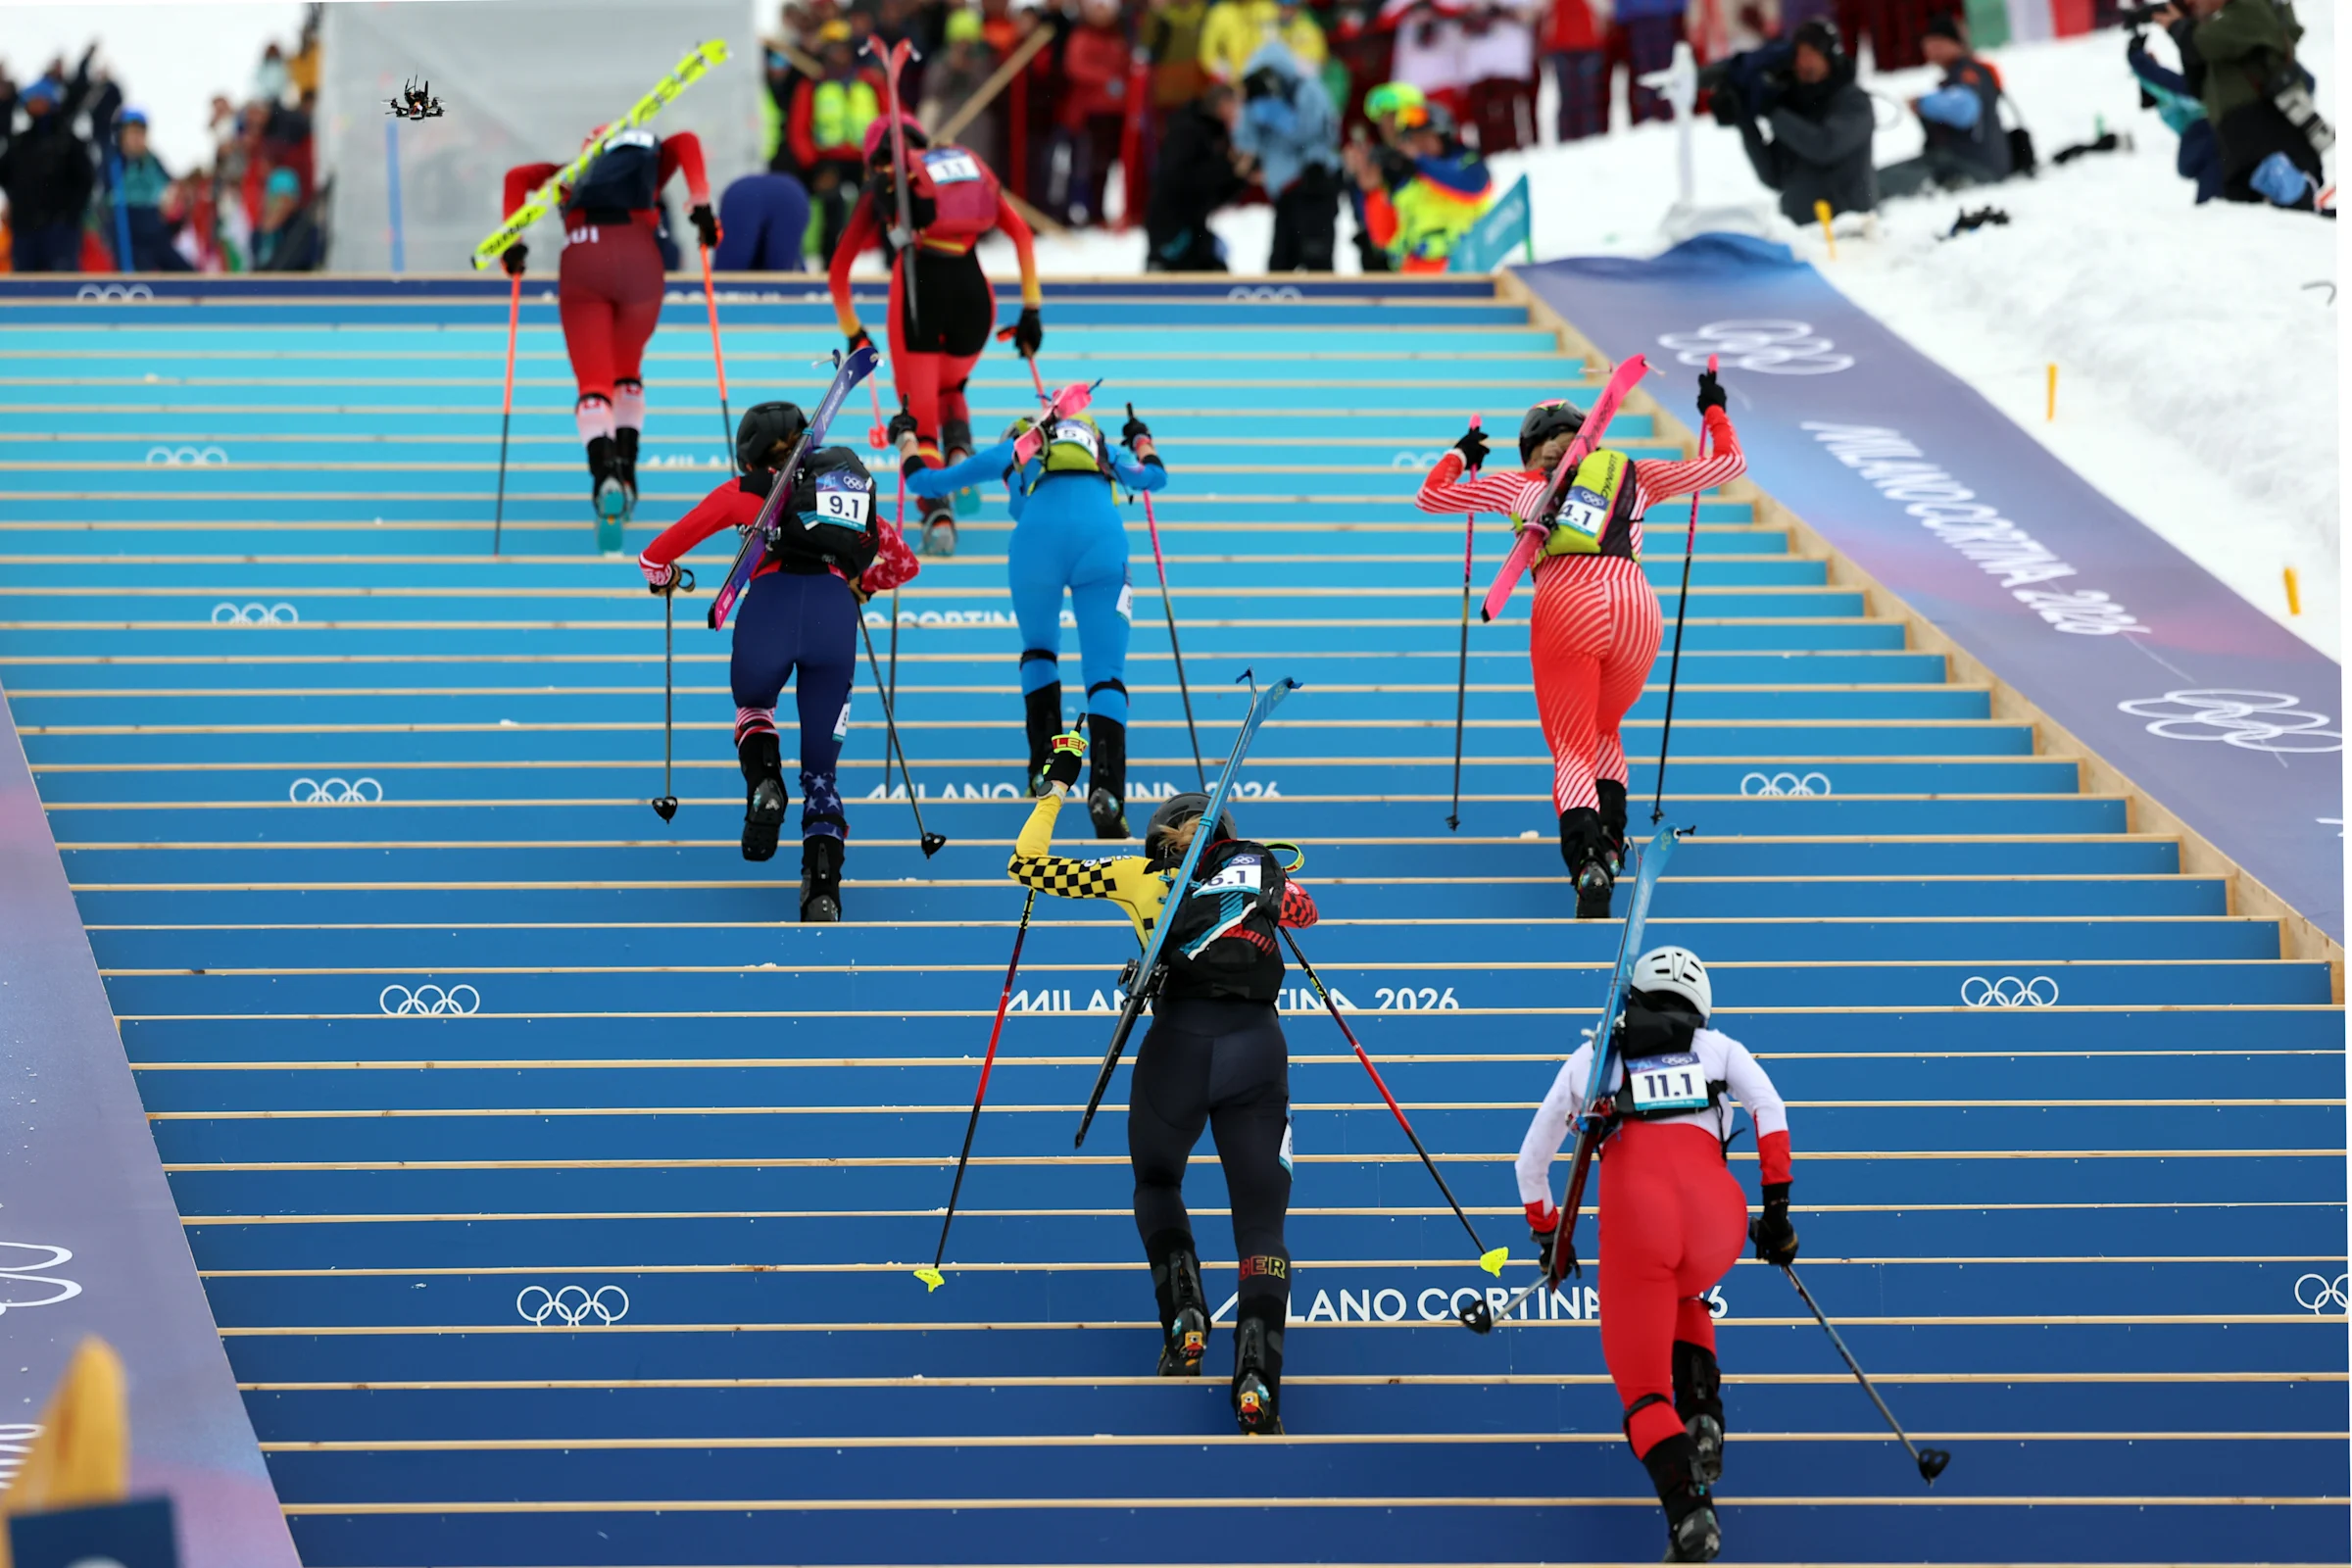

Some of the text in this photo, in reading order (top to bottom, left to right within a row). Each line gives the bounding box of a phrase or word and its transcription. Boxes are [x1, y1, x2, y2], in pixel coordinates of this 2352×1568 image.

[829, 494, 860, 520] 9.1
[1558, 503, 1592, 526] 4.1
[896, 610, 1017, 624] CORTIN
[1005, 987, 1459, 1011] MILAN TINA 2026
[1643, 1072, 1694, 1099] 11.1
[1211, 1289, 1406, 1322] LANO
